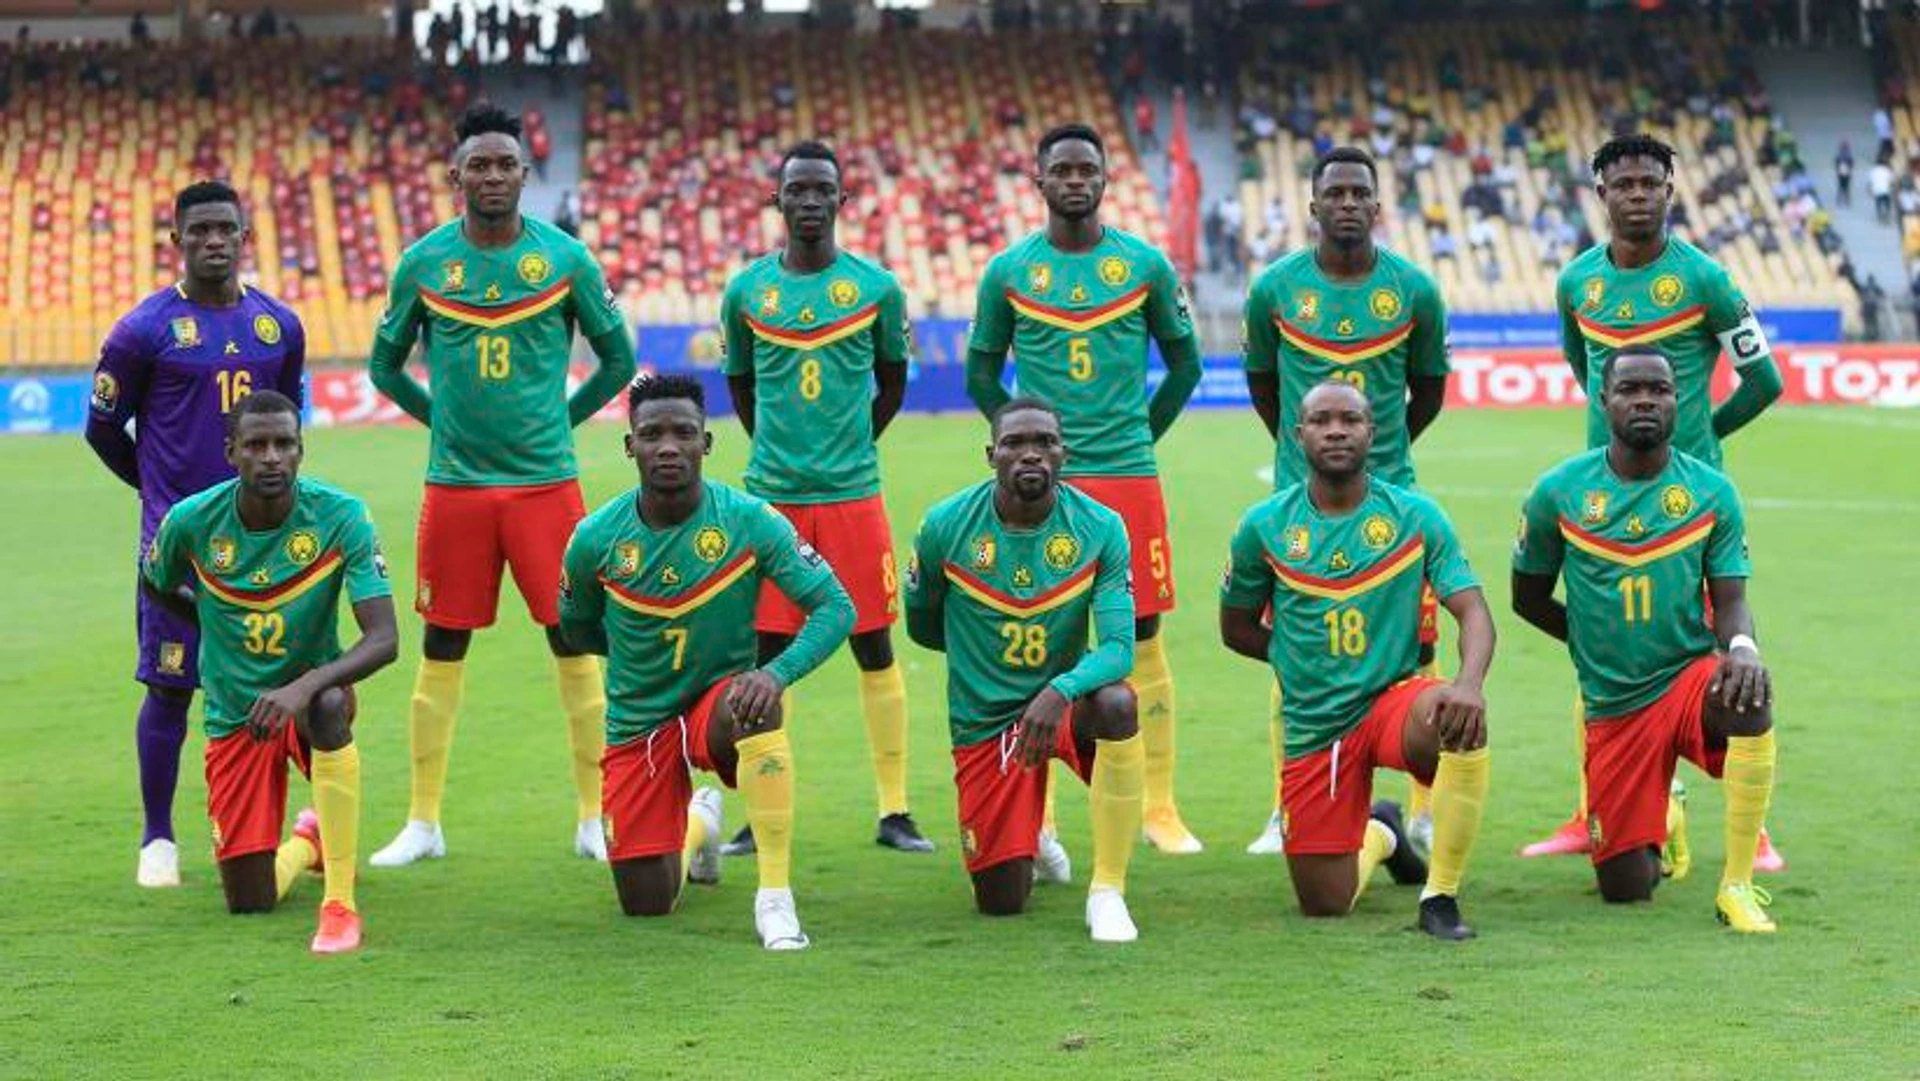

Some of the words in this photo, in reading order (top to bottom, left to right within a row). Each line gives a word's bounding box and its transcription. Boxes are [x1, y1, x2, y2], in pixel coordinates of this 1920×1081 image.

[475, 335, 509, 379] 13
[1069, 337, 1092, 380] 5
[1731, 328, 1760, 358] C
[216, 370, 251, 413] 16
[799, 359, 822, 401] 8
[1450, 357, 1587, 404] TOT
[1789, 351, 1920, 406] TOT
[881, 552, 896, 594] 8
[1149, 538, 1166, 580] 5
[1617, 575, 1651, 621] 11
[242, 612, 288, 655] 32
[663, 629, 688, 671] 7
[1000, 622, 1047, 666] 28
[1323, 606, 1367, 656] 18
